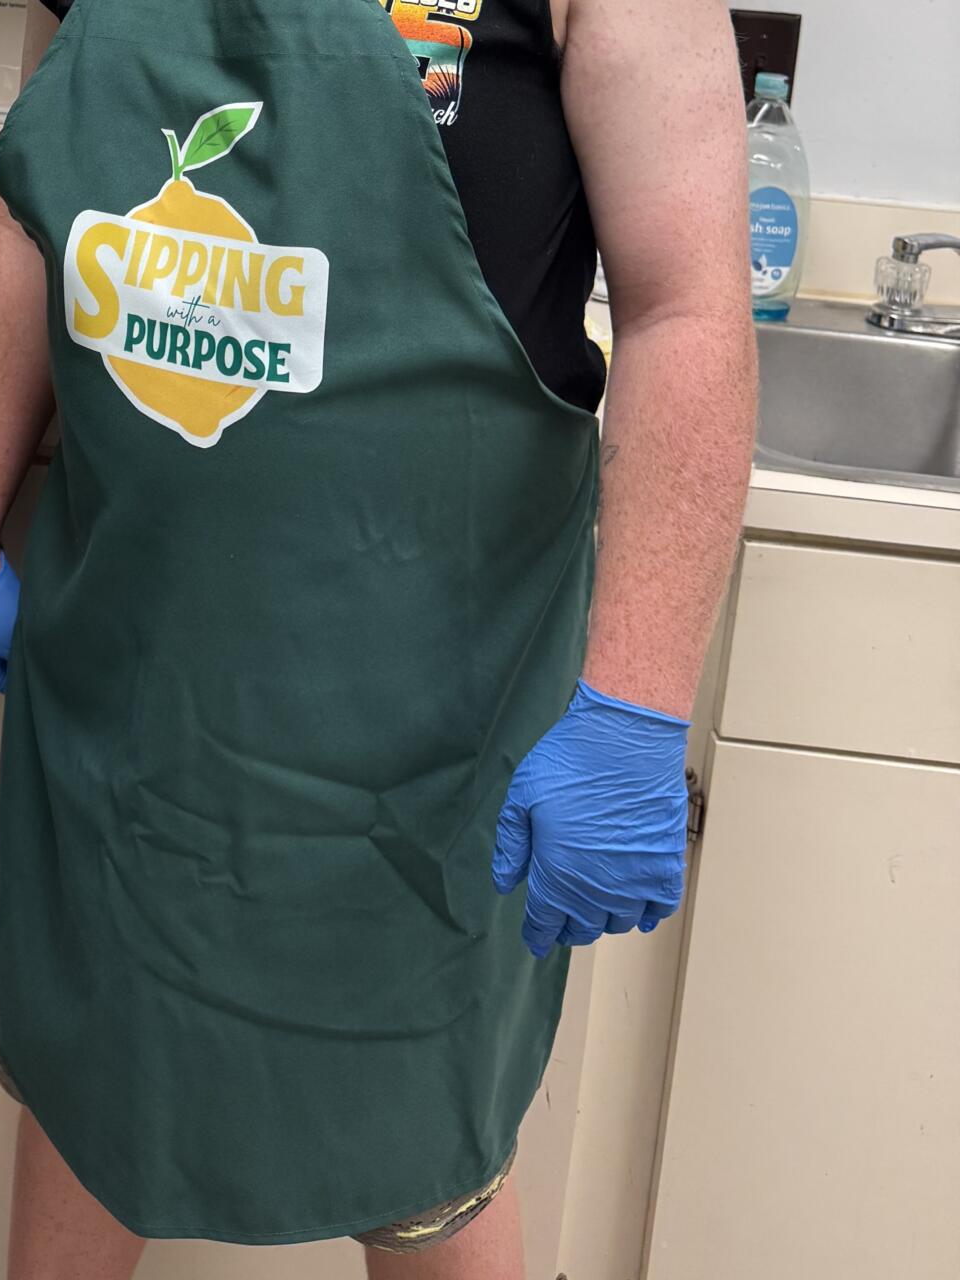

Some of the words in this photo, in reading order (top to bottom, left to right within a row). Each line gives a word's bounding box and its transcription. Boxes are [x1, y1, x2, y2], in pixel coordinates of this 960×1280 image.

[766, 225, 791, 237] soap
[74, 221, 305, 340] SIPPING
[166, 295, 210, 328] with
[208, 315, 221, 327] a
[123, 312, 292, 383] PURPOSE
